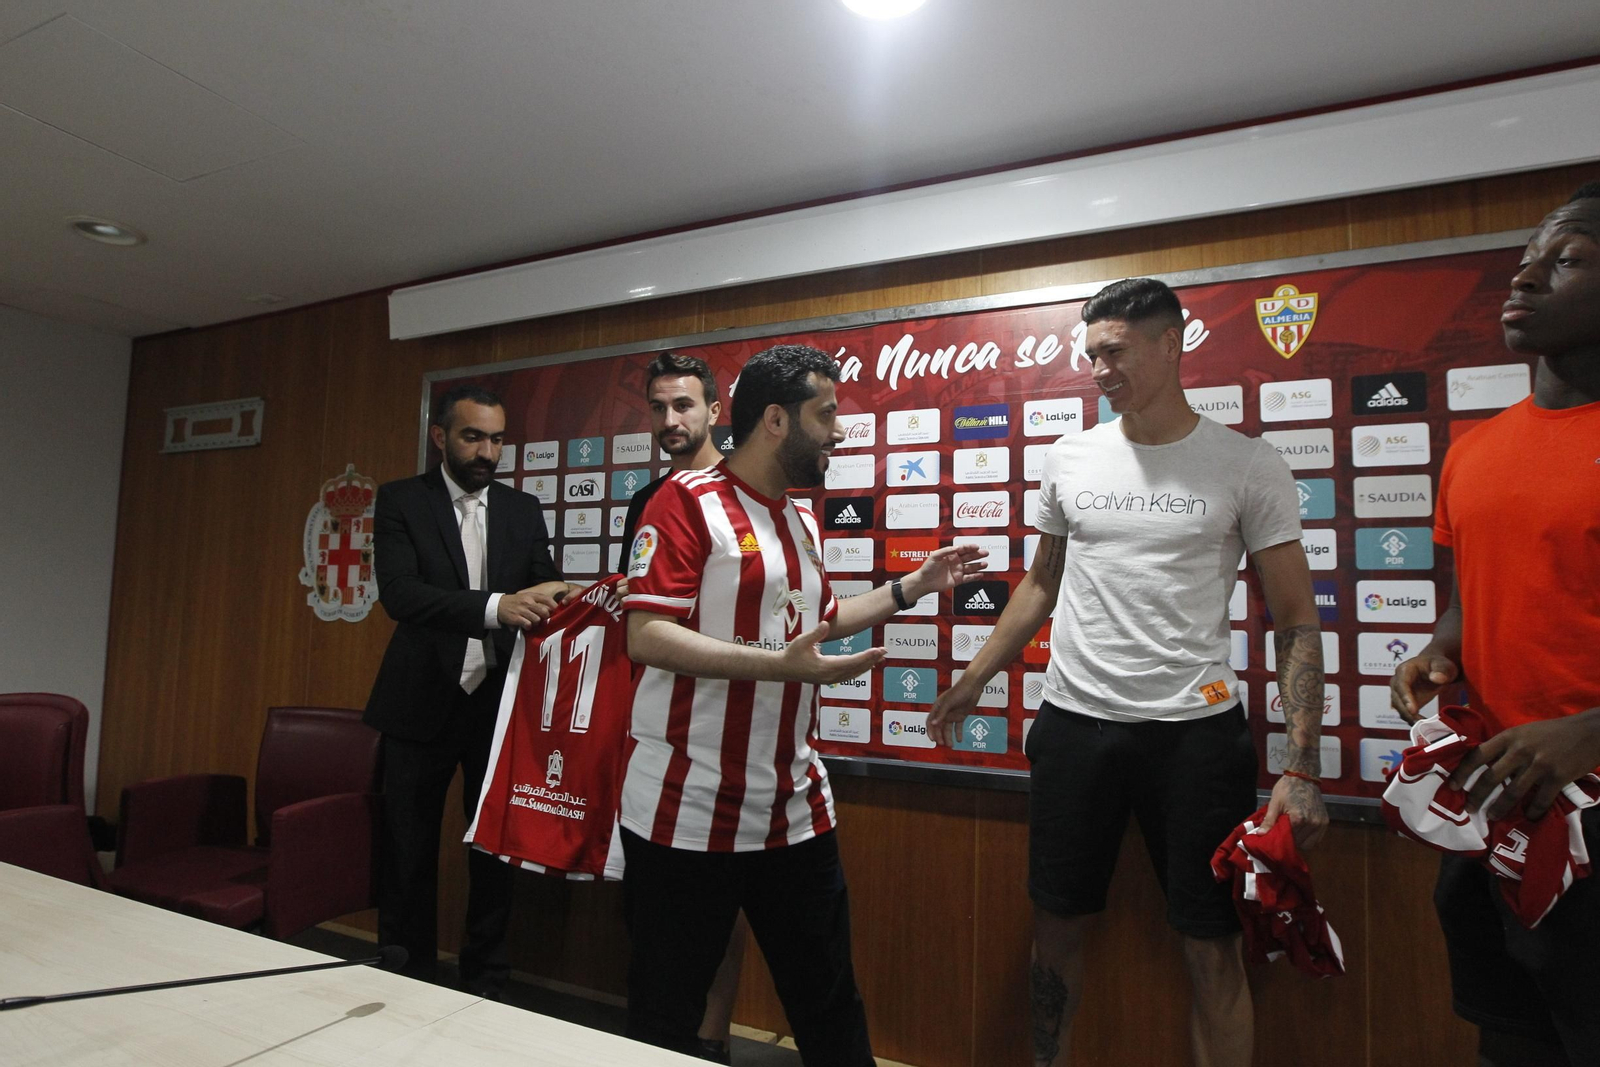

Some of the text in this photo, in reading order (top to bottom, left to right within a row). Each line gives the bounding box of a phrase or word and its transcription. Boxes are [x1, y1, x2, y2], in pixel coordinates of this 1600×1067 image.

[1264, 313, 1311, 325] ALMERIA
[876, 334, 1001, 391] Nunca
[1014, 334, 1063, 368] se
[1290, 391, 1312, 399] ASG
[1189, 401, 1240, 412] SAUDIA
[1367, 397, 1409, 408] adidas
[988, 415, 1008, 426] HILL
[1046, 412, 1077, 424] LaLiga
[1385, 436, 1408, 444] ASG
[620, 444, 650, 454] SAUDIA
[1276, 444, 1330, 455] SAUDIA
[536, 452, 555, 460] LaLiga
[569, 484, 594, 497] CASI
[1367, 492, 1427, 503] SAUDIA
[1075, 491, 1207, 516] Calvin Klein
[956, 500, 1006, 519] Coca-Cola
[835, 516, 861, 524] adidas
[1305, 545, 1329, 555] Liga
[582, 584, 623, 623] UÑOZ
[965, 600, 995, 609] adidas
[1386, 597, 1427, 608] LaLiga
[895, 638, 937, 647] SAUDIA
[540, 626, 606, 734] 11
[984, 686, 1005, 695] DIA
[904, 724, 926, 735] LaLig
[972, 741, 986, 749] PDR
